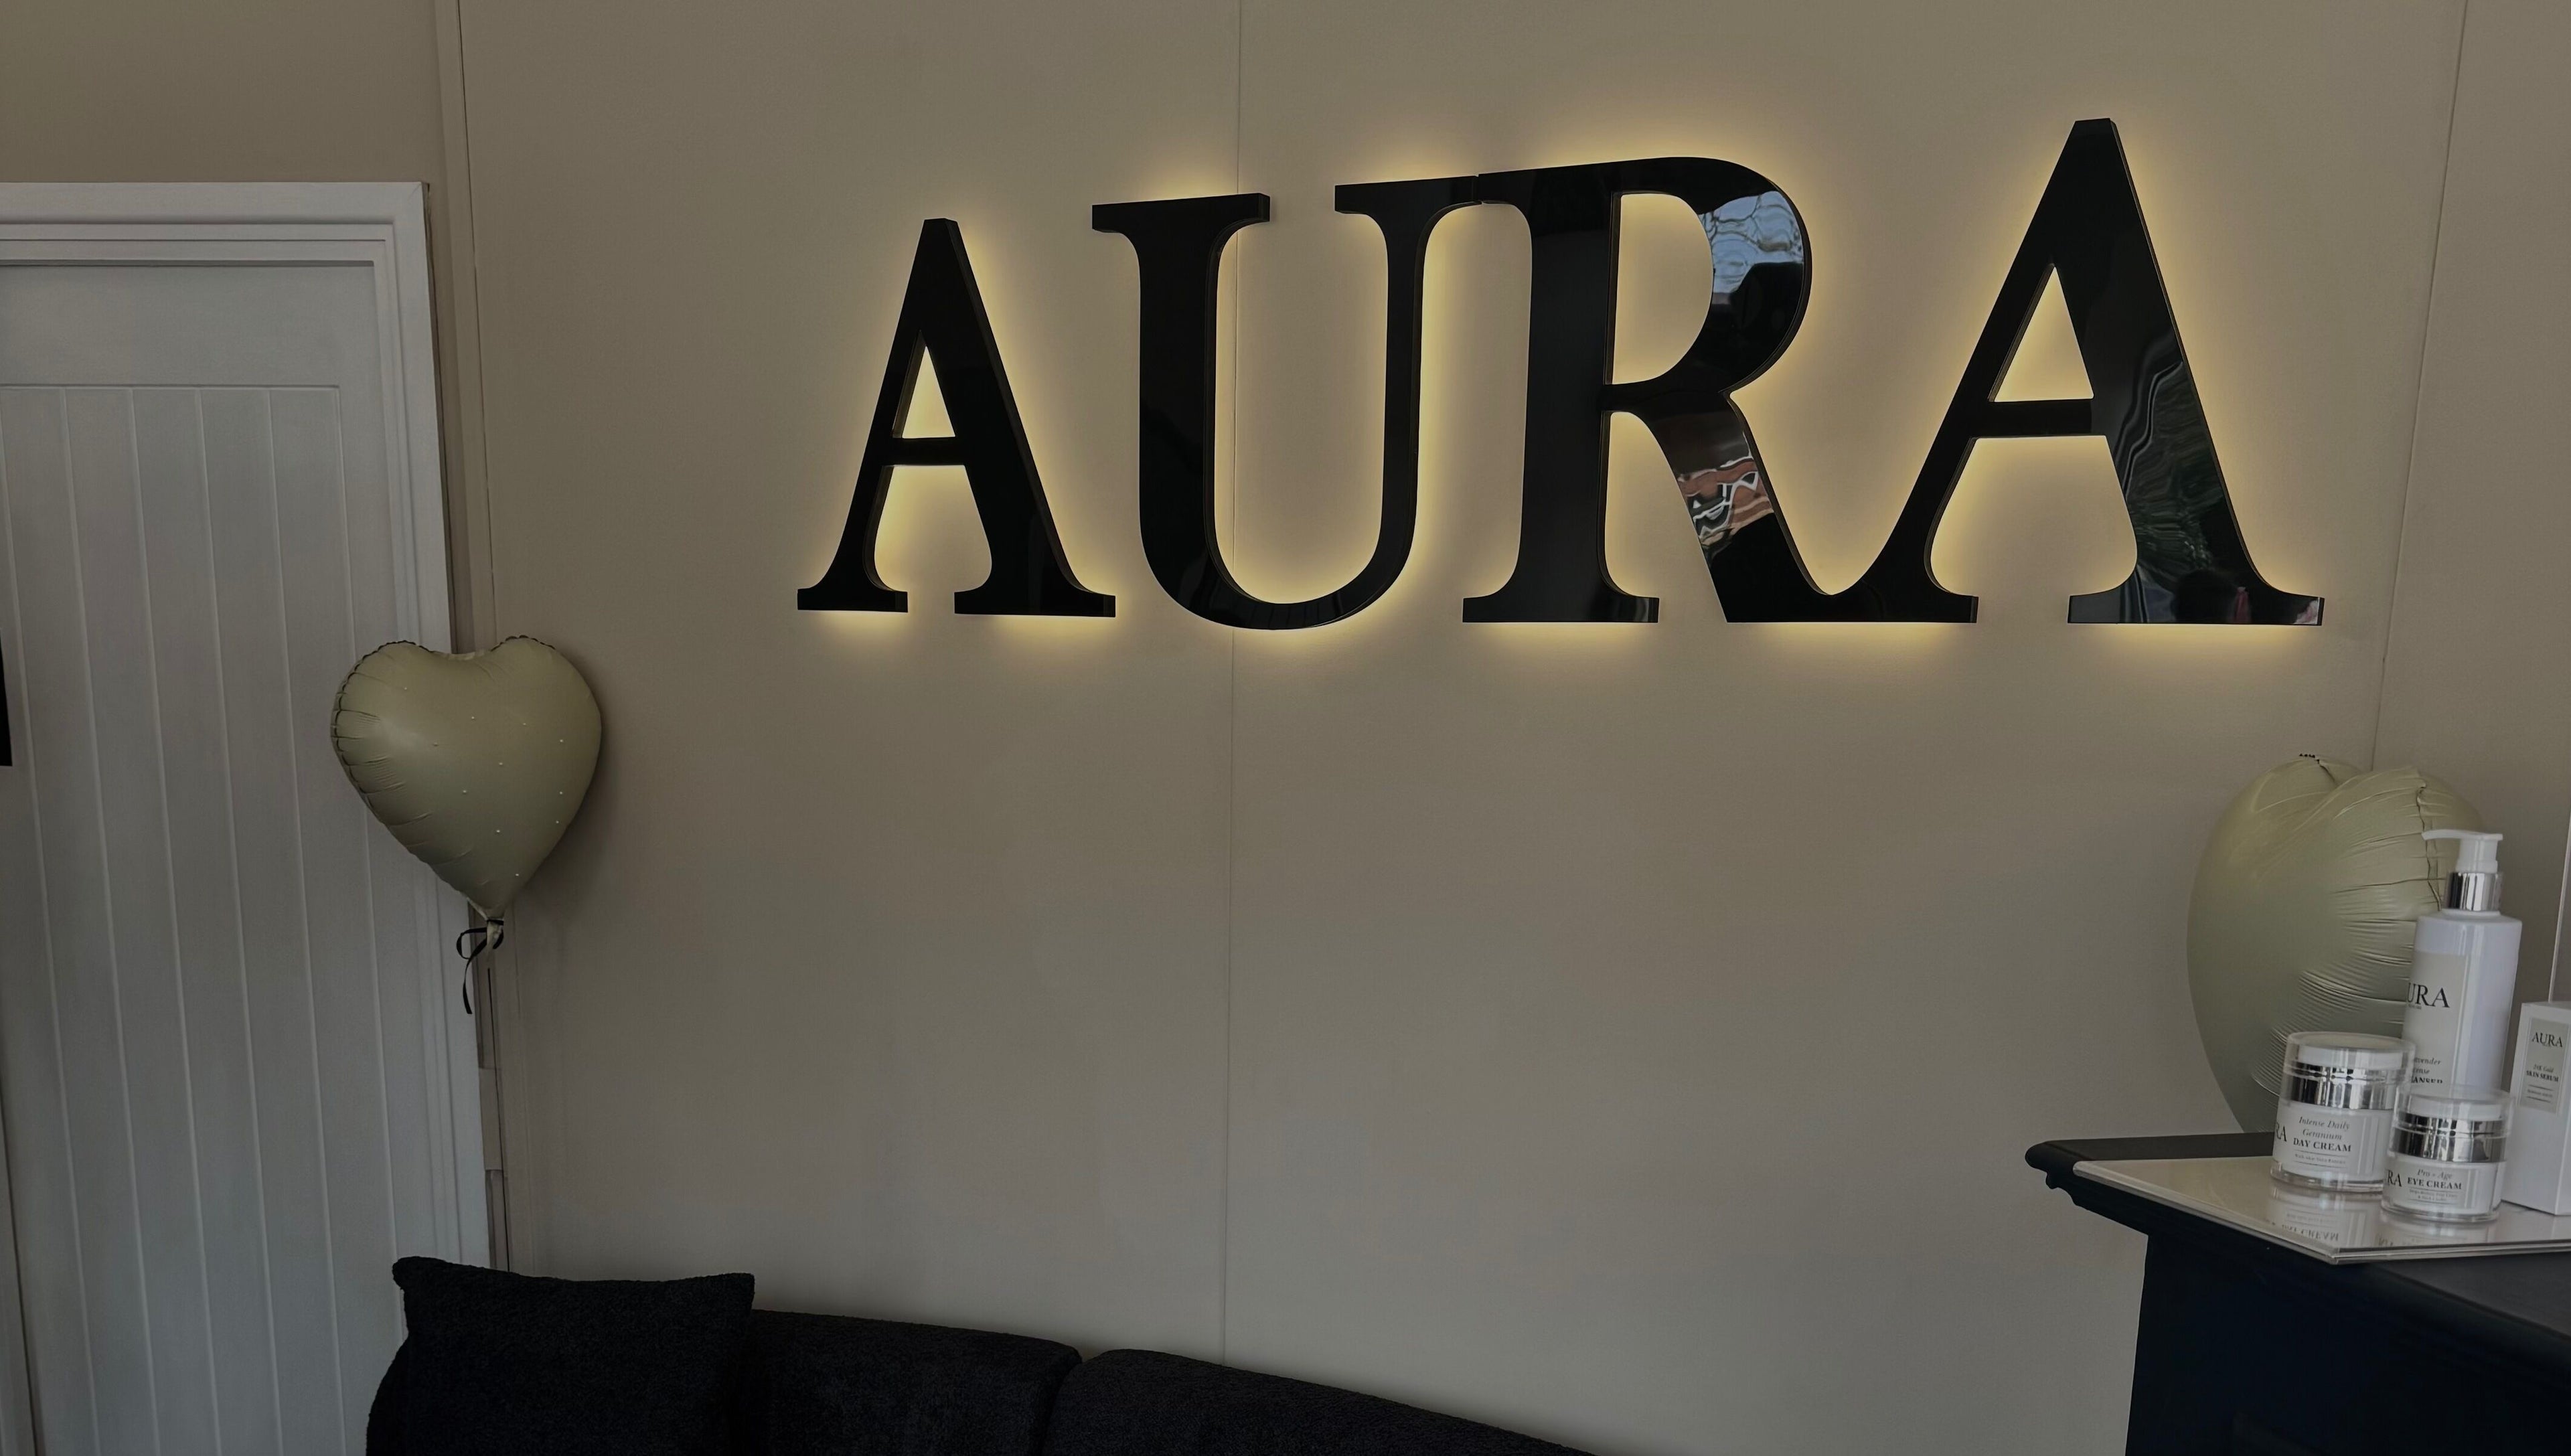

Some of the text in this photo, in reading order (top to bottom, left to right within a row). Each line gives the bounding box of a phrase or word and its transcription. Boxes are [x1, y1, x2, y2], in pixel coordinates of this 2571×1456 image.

[797, 118, 2325, 629] AURA
[2407, 982, 2450, 1008] URA
[2531, 1032, 2563, 1048] AURA
[2276, 1121, 2287, 1142] RA
[2299, 1116, 2350, 1131] Intense Daily
[2293, 1137, 2352, 1152] DAY CREAM
[2385, 1169, 2402, 1187] RA
[2407, 1177, 2463, 1190] EYE CREAM
